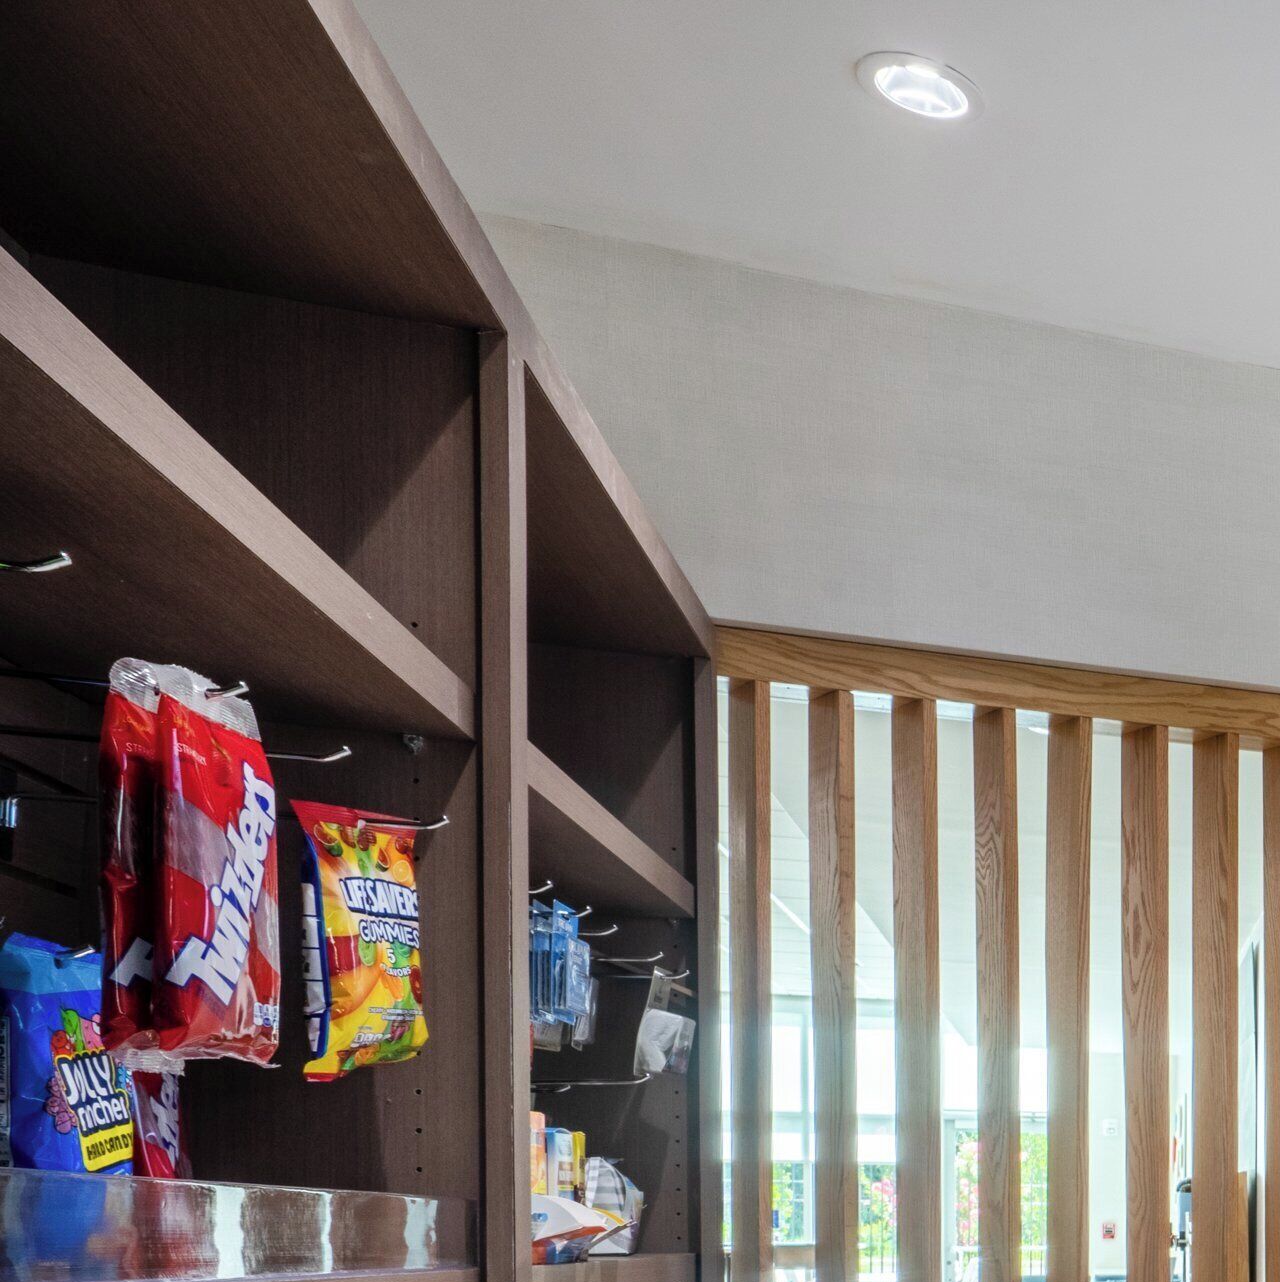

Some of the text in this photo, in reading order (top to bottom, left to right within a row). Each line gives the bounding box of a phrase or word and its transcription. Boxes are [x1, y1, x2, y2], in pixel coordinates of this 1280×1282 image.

[164, 761, 277, 1006] Twizzlers
[358, 919, 420, 949] GUMMIES
[379, 962, 412, 977] FLAVORS
[386, 948, 396, 964] 5
[61, 1055, 114, 1106] JOLLY
